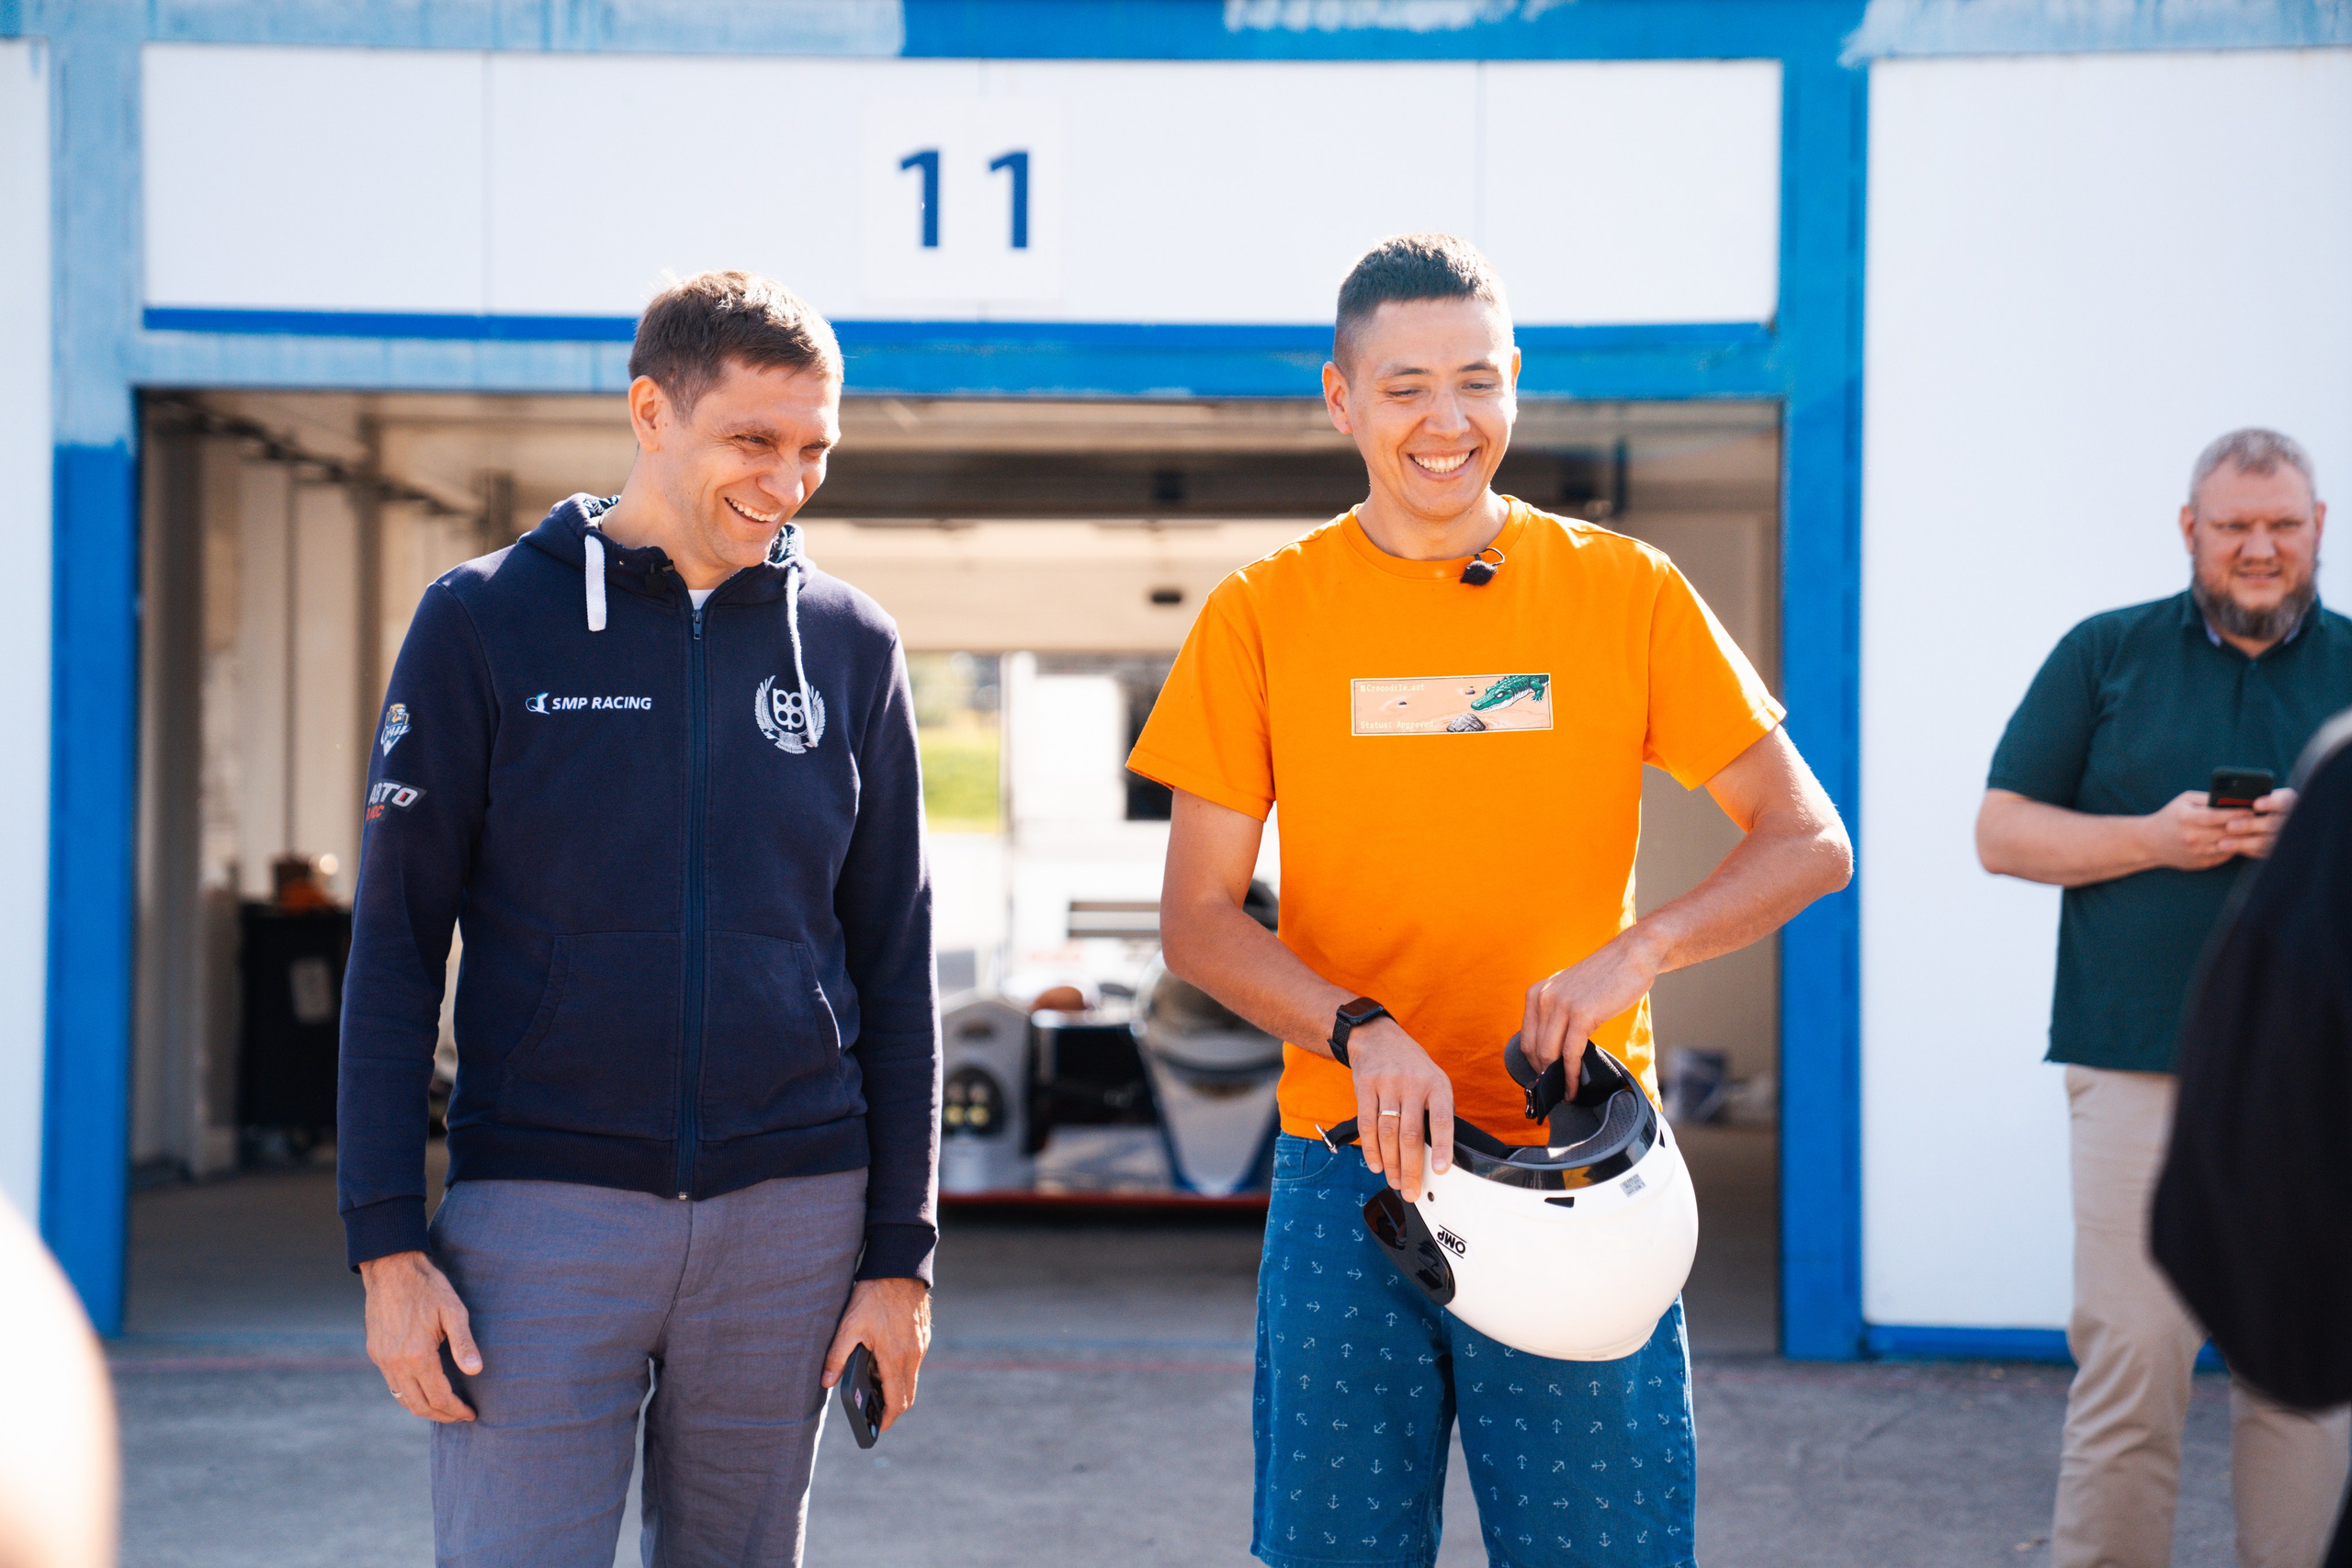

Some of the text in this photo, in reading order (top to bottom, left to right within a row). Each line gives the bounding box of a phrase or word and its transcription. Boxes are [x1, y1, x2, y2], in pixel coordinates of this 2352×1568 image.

[899, 149, 1027, 247] 11
[551, 695, 652, 710] SMP RACING
[1360, 719, 1433, 730] Status: Approved
[1437, 1230, 1466, 1254] OMP
